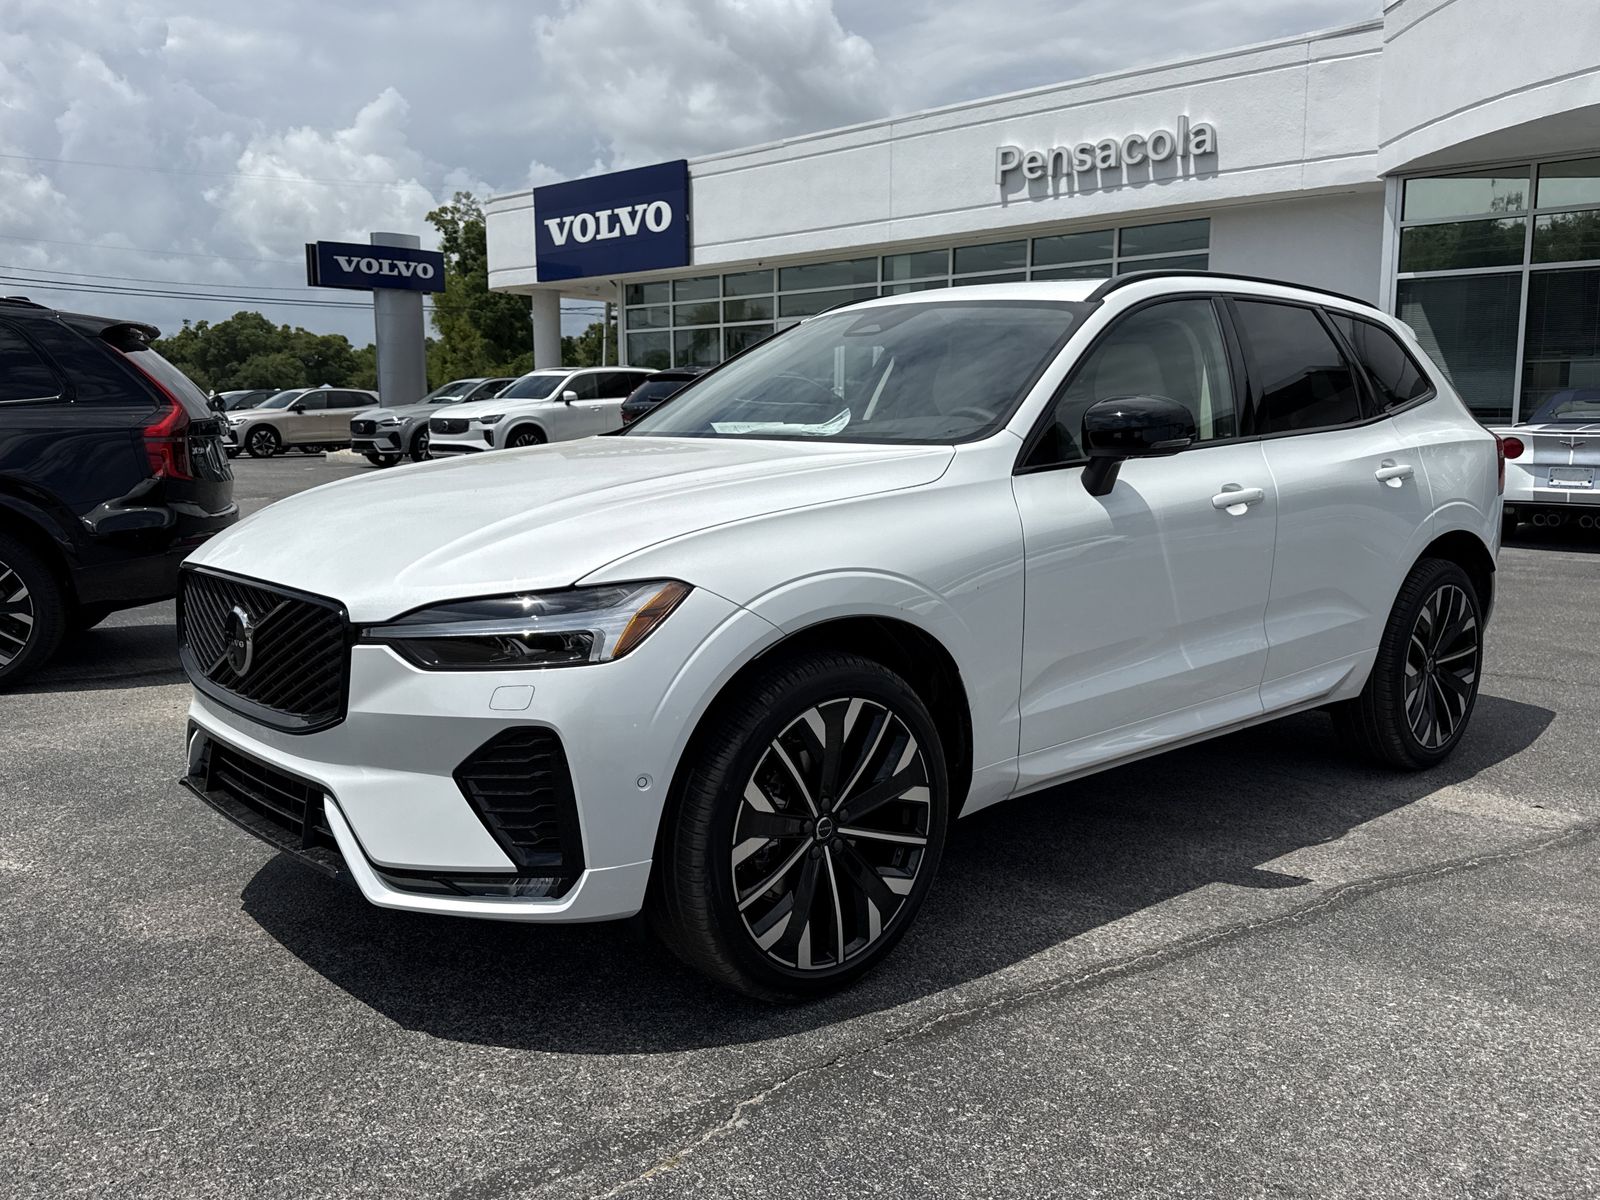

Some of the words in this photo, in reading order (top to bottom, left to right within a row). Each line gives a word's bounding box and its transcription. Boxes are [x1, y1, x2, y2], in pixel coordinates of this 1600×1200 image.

[995, 115, 1216, 185] Pensacola
[544, 201, 673, 246] VOLVO
[333, 255, 434, 279] VOLVO
